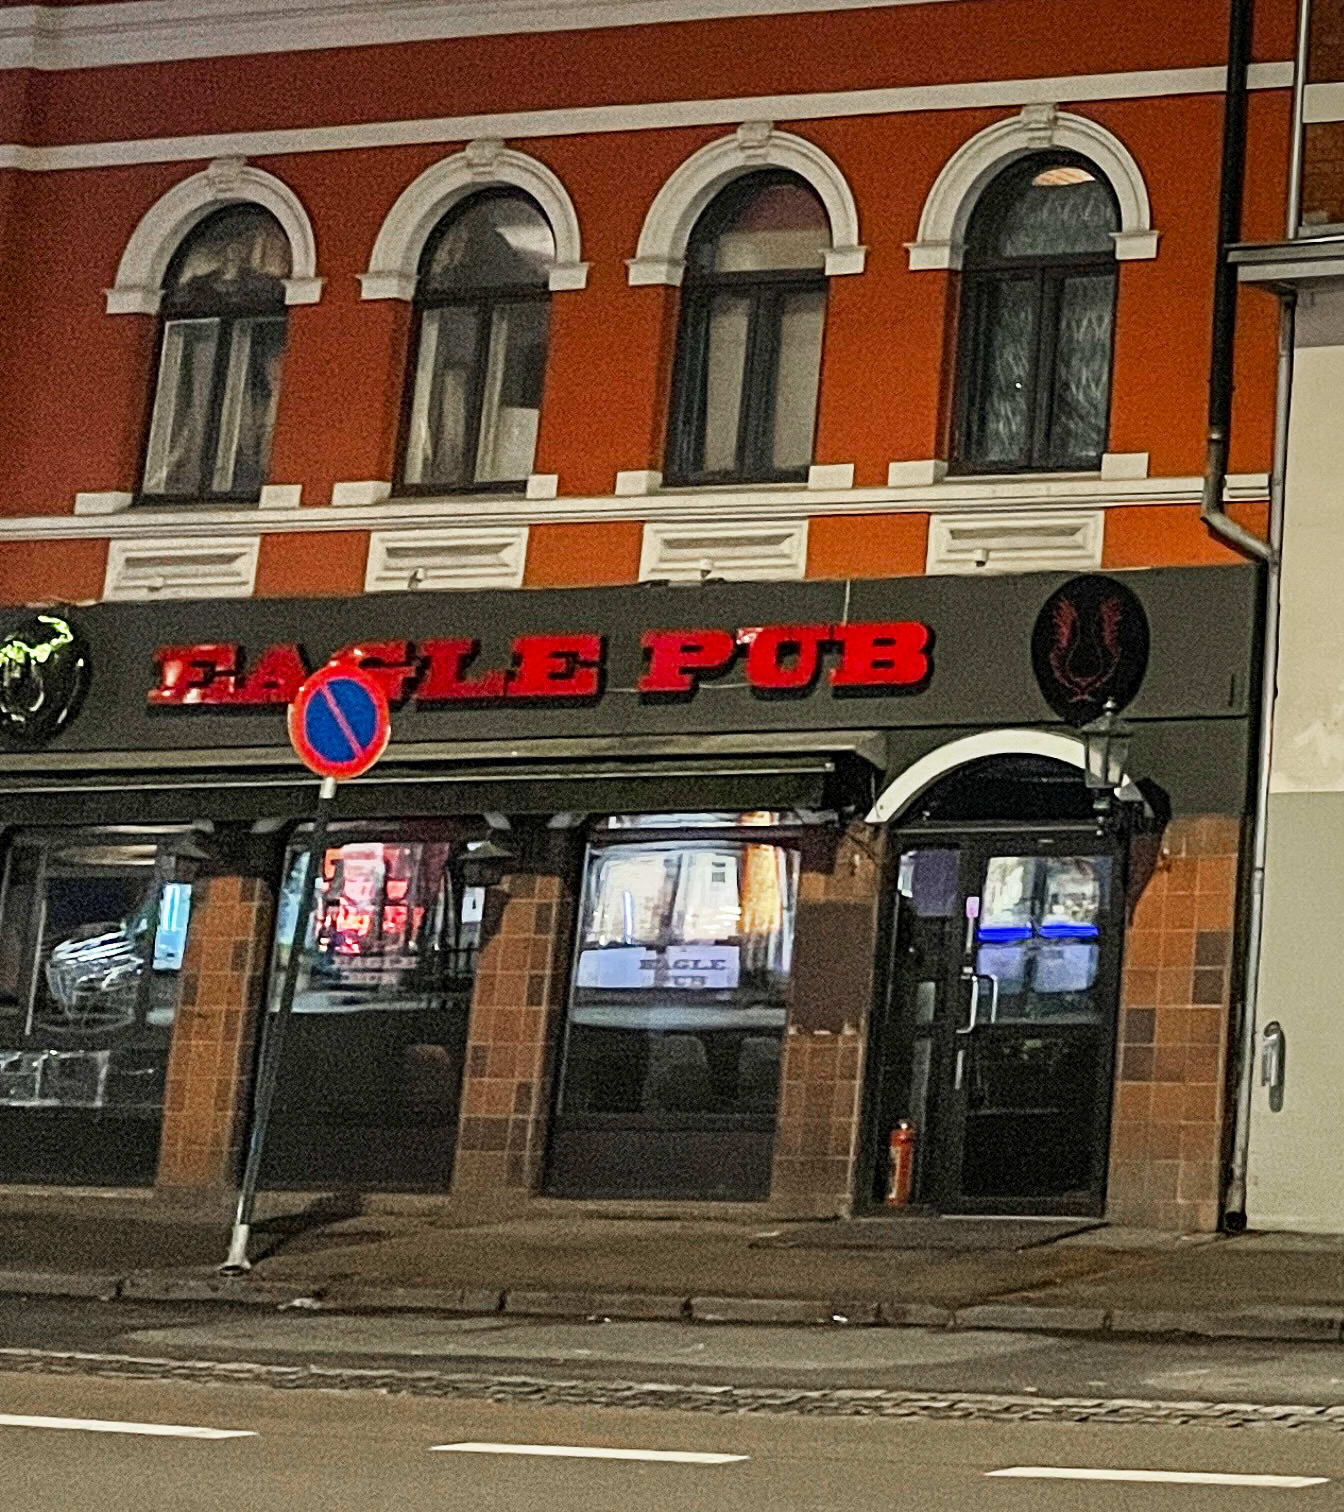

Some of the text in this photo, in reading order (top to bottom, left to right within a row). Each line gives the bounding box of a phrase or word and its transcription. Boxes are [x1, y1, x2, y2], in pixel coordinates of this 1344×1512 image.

[147, 620, 932, 705] EAGLE PUB
[638, 958, 728, 971] EAGLE
